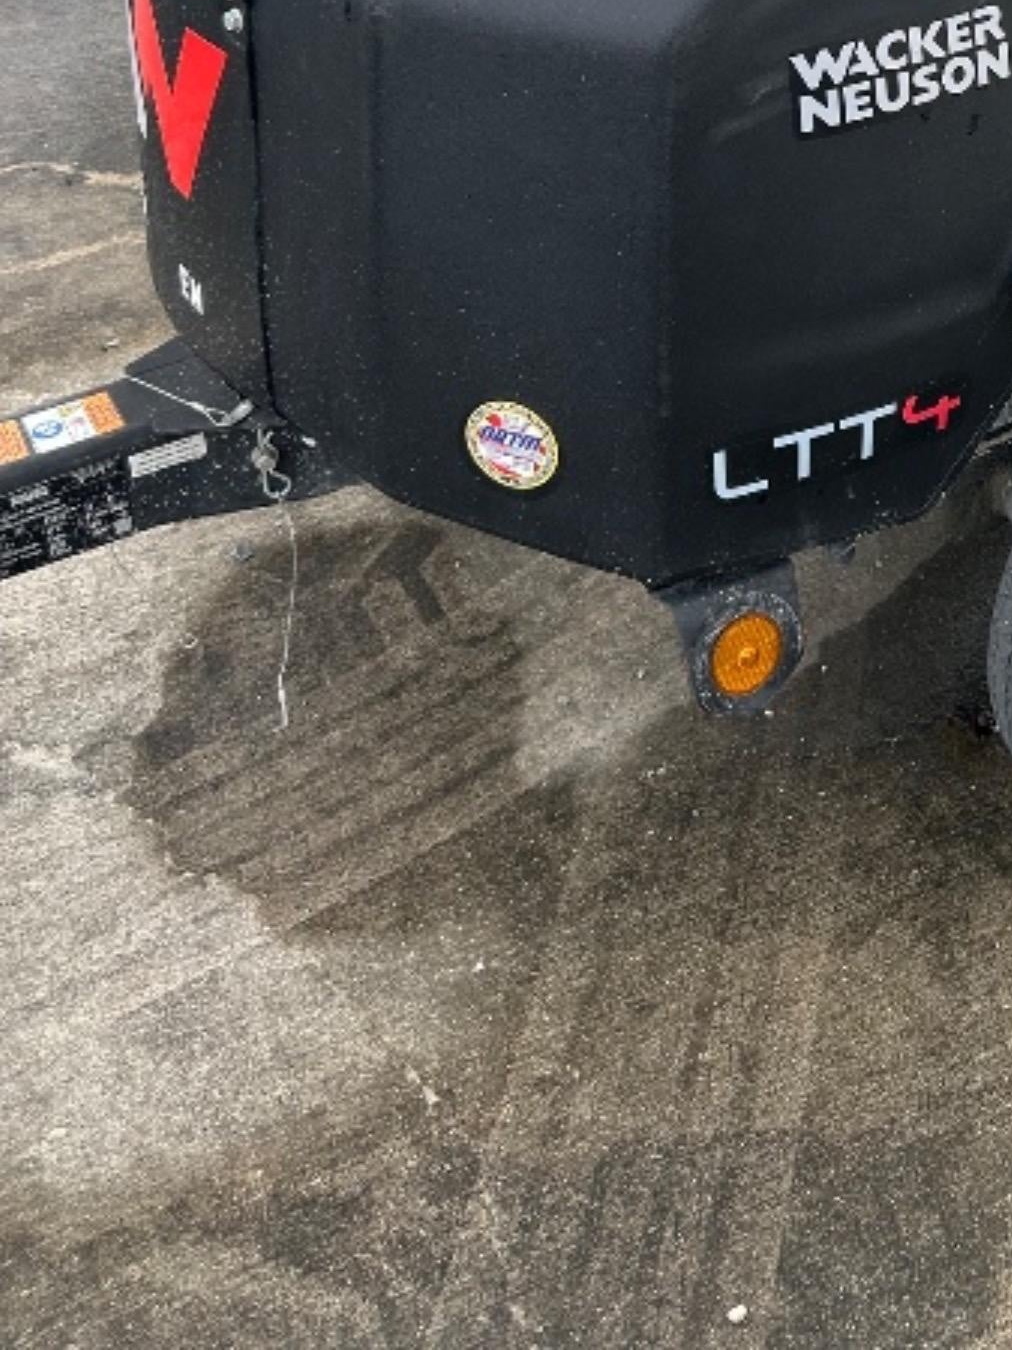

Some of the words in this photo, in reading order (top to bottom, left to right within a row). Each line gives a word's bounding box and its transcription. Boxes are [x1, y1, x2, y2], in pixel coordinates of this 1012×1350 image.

[788, 4, 1006, 92] WACKER
[798, 40, 1012, 134] NEUSON
[712, 394, 961, 501] LTT4
